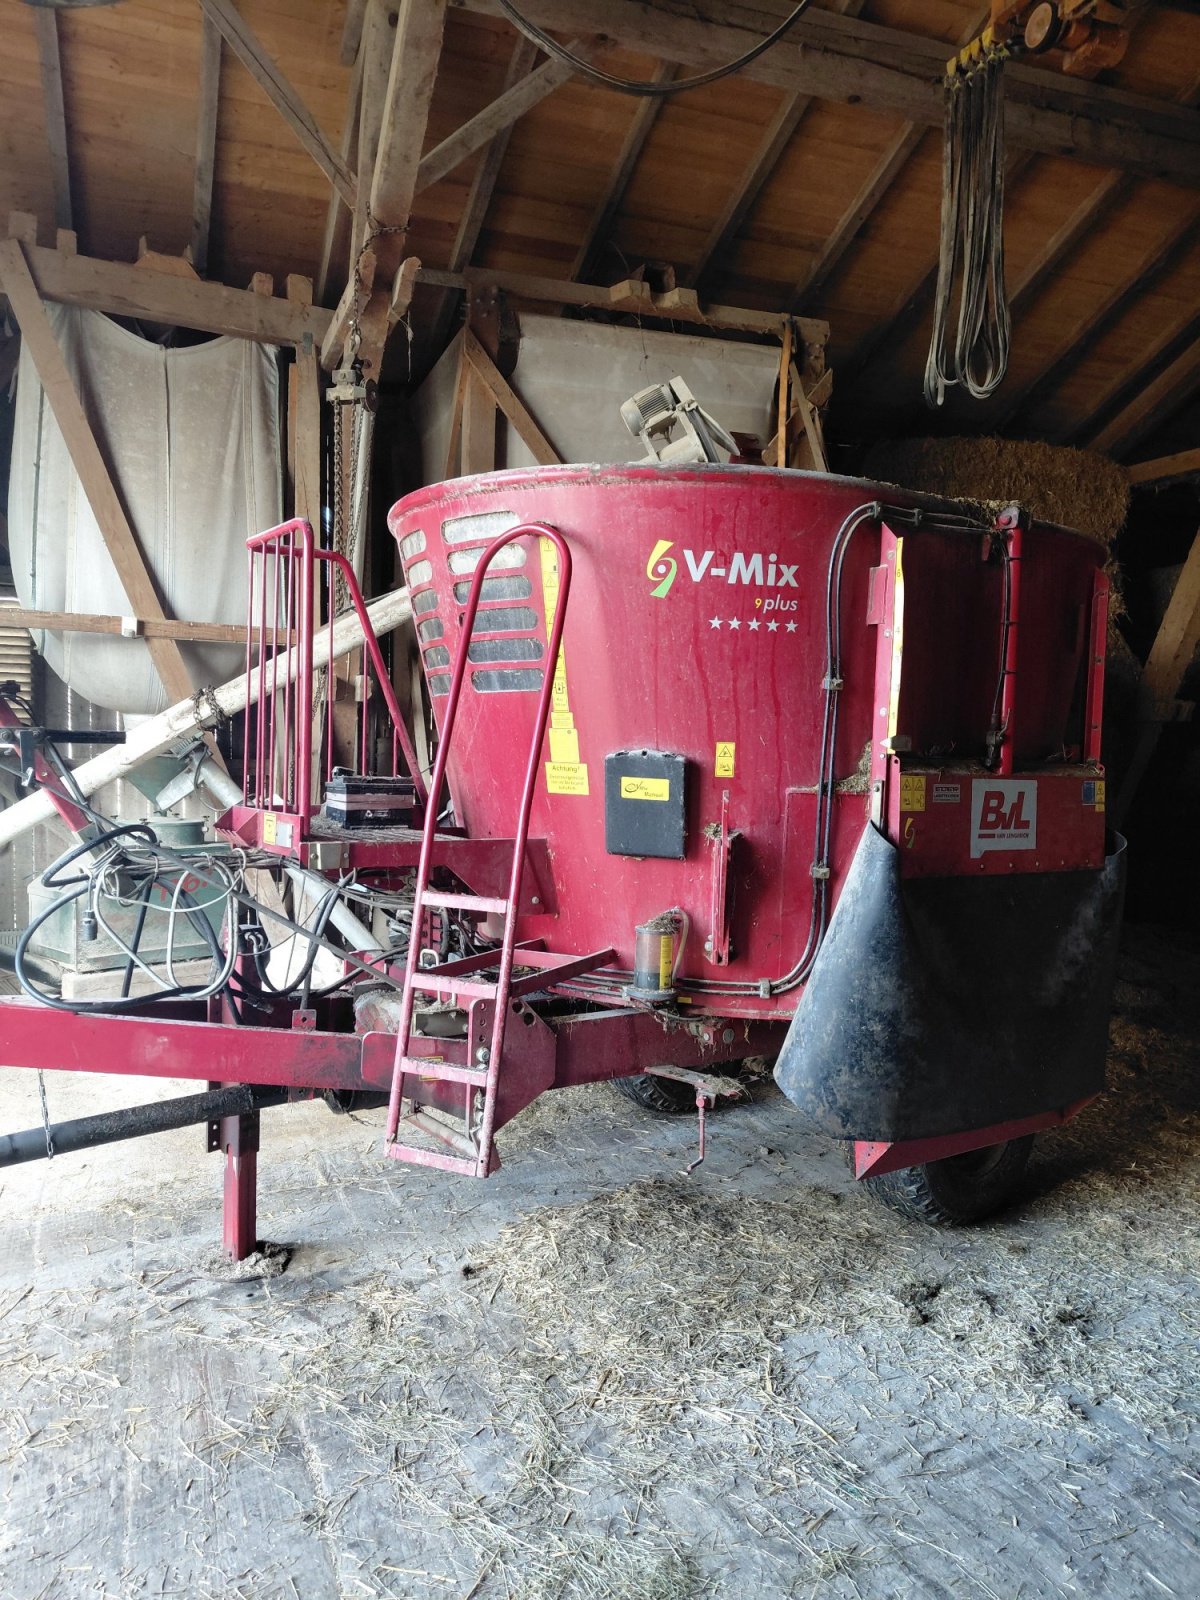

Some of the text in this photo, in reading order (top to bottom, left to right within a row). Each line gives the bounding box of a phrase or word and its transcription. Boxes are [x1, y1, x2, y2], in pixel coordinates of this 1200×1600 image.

[683, 549, 800, 587] V-Mix
[755, 594, 798, 614] 9 plus
